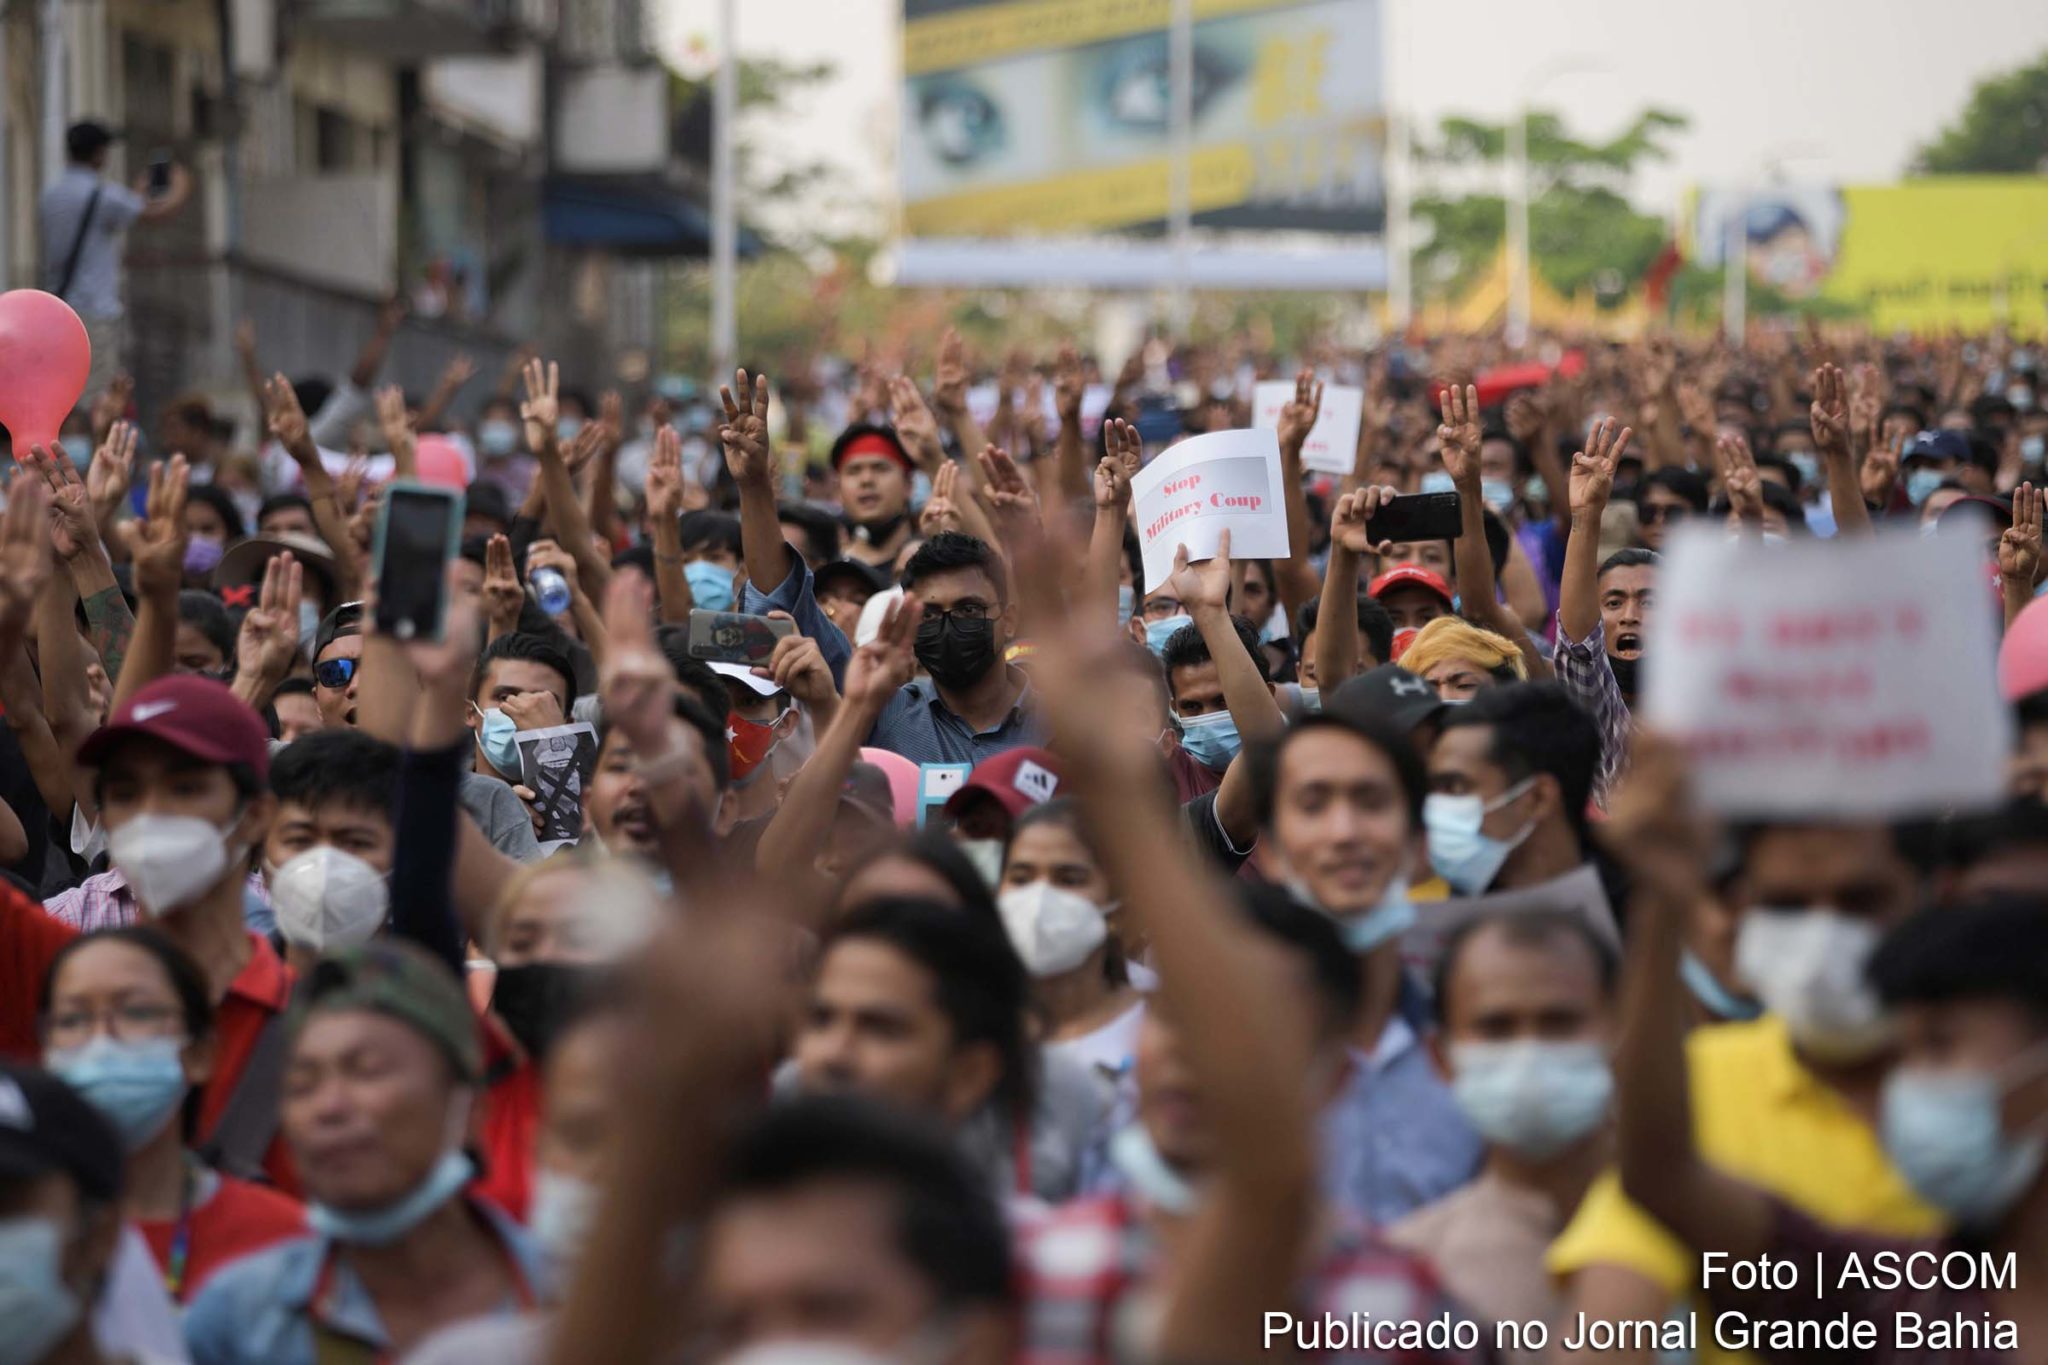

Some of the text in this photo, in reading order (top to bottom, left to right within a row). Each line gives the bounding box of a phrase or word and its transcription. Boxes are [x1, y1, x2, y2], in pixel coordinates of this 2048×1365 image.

[1163, 475, 1200, 498] Stop
[1146, 493, 1262, 542] Military Coup
